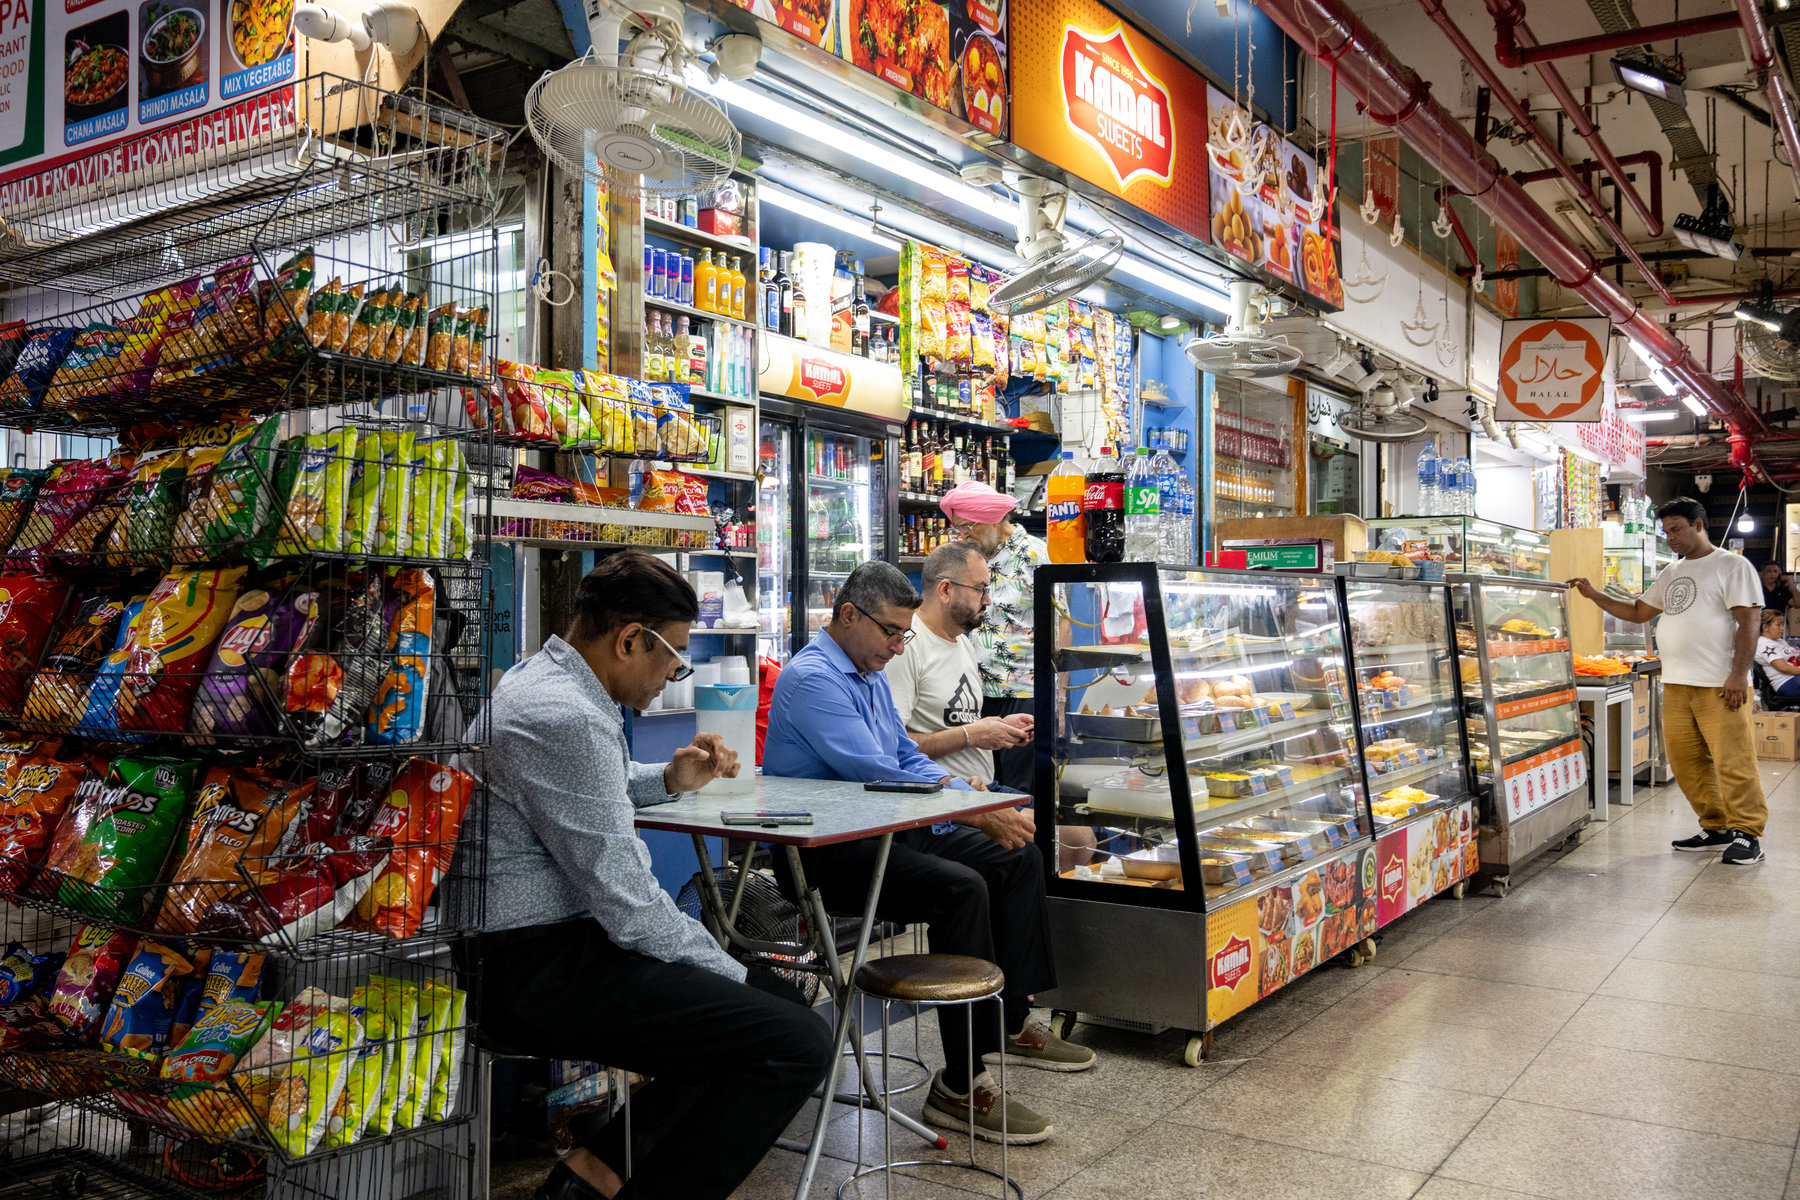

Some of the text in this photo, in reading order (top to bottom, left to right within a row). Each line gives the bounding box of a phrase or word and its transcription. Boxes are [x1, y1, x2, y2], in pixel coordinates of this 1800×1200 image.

[224, 59, 292, 95] MIX VEGETABLE
[1101, 52, 1134, 82] SINCE 1996
[141, 89, 206, 120] BHINDI MASALA
[1075, 50, 1165, 148] KAMAL
[67, 115, 126, 142] CHANA MASALA
[1096, 113, 1143, 160] SWEETS
[0, 97, 294, 207] AND PROVIDE HOME DELIVERY
[805, 362, 843, 385] KAMAL
[1519, 353, 1582, 384] حلال
[811, 379, 832, 391] SWEETS
[1247, 541, 1279, 560] EMIUM
[222, 626, 270, 654] Lay's
[113, 818, 147, 831] ROASTED
[116, 826, 137, 835] CORN
[215, 833, 244, 848] TACO
[134, 963, 156, 979] Calbee
[212, 962, 233, 973] Calbee
[1216, 946, 1249, 977] KAMAL
